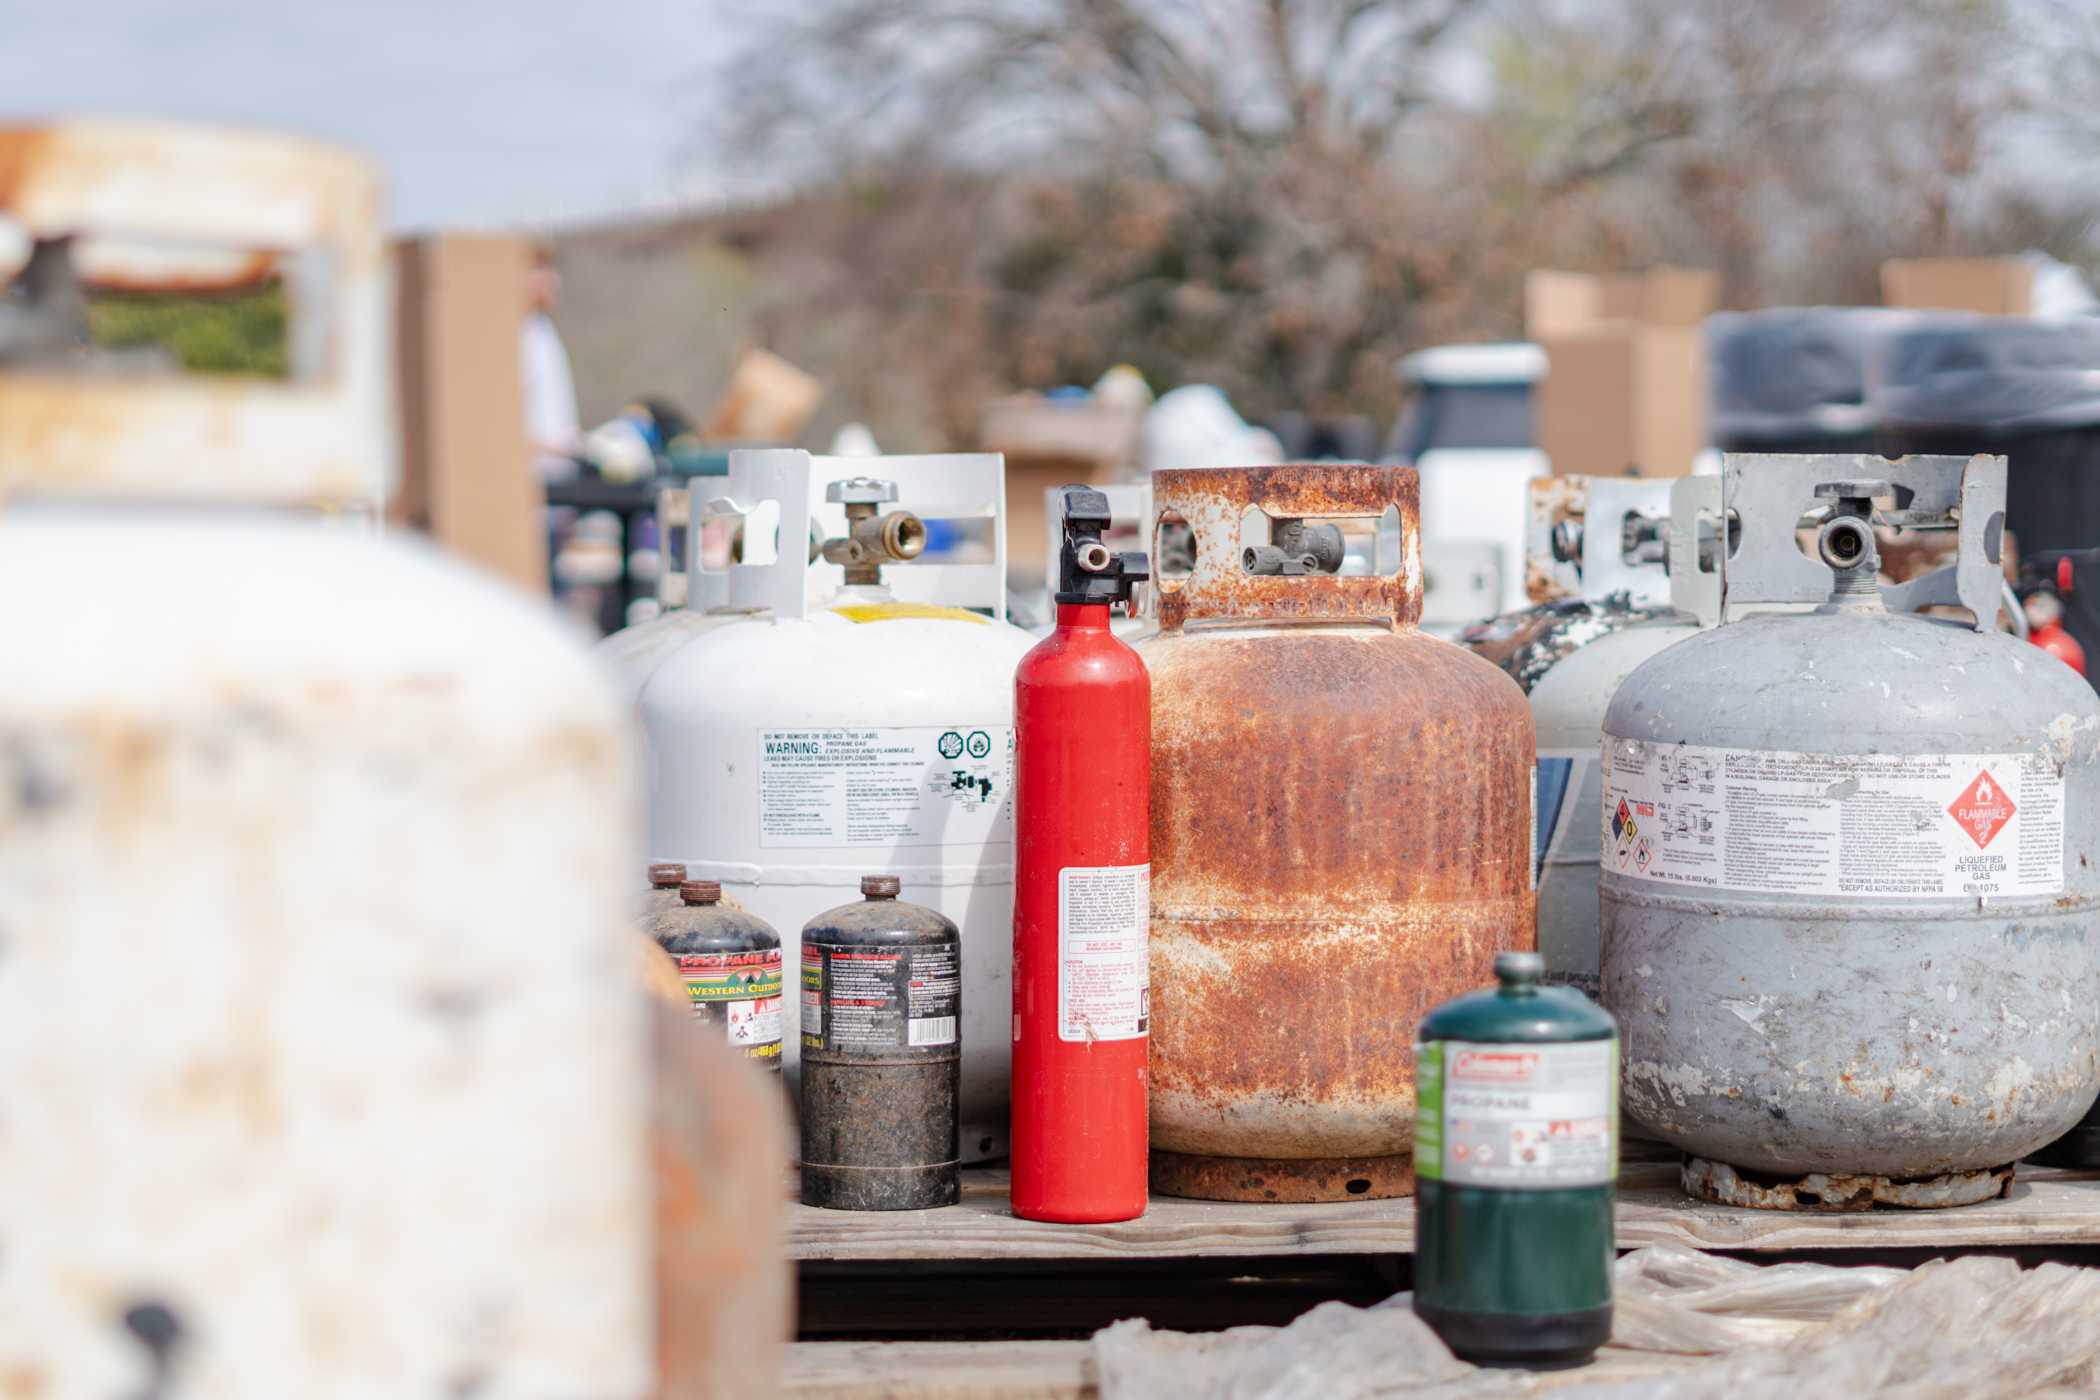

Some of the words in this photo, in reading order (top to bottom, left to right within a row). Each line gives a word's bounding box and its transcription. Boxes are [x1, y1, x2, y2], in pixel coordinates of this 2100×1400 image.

[766, 741, 823, 755] WARNING:
[1959, 855, 2004, 864] LIQUEFIED
[1954, 863, 2007, 872] PETROLEUM
[1972, 872, 1991, 881] GAS
[1874, 885, 1911, 893] AUTHORIZED
[688, 986, 745, 996] WESTERN
